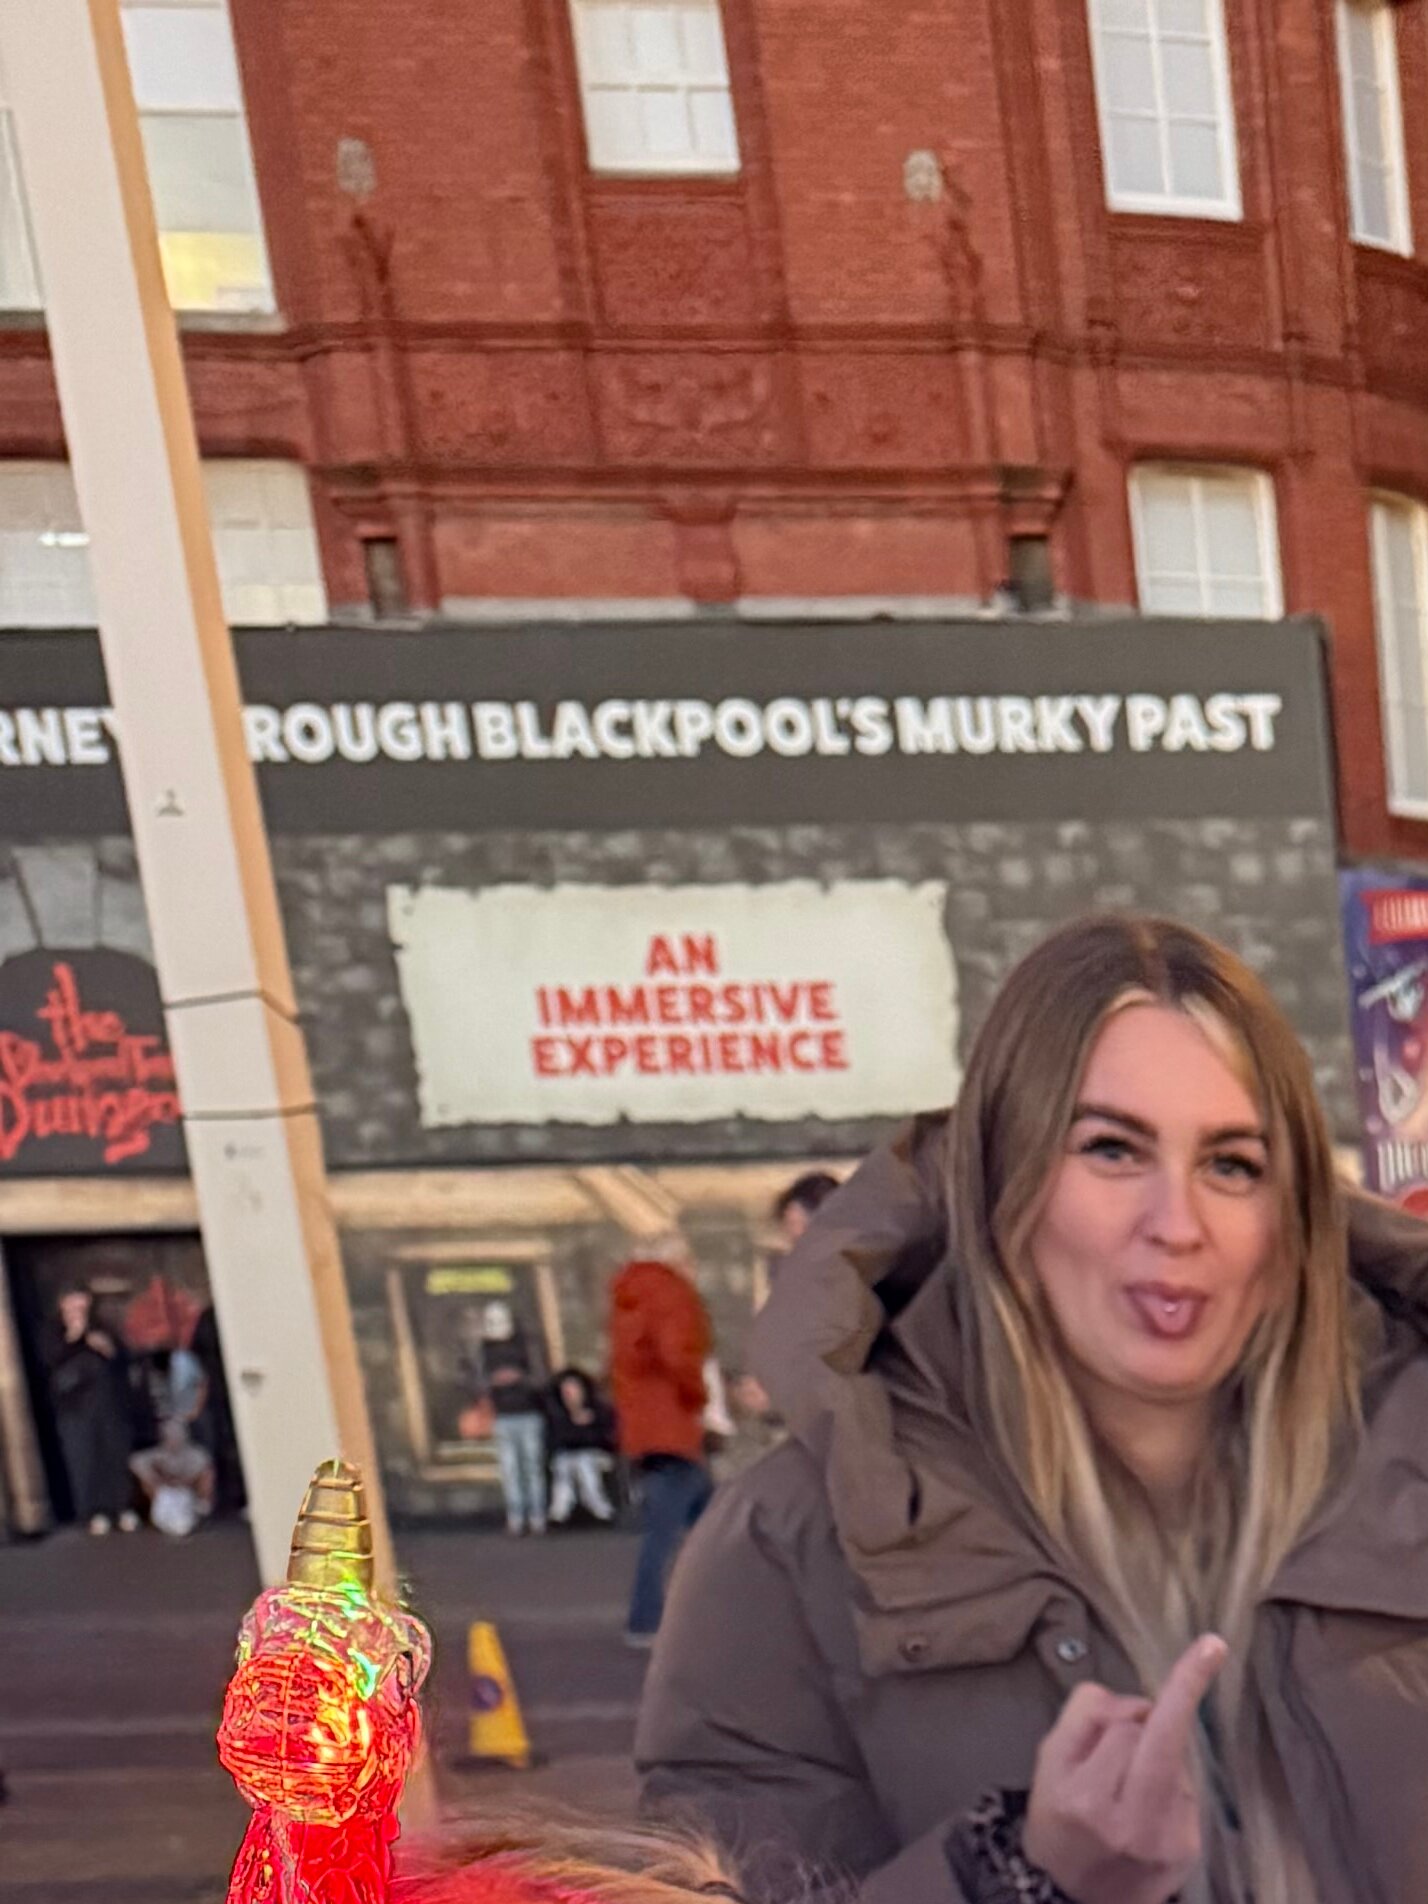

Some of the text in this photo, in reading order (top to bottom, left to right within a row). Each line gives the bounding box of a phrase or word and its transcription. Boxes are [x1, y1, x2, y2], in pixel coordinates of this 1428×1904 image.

[474, 697, 893, 763] BLACKPOOL'S
[898, 694, 1121, 755] MURKY
[1125, 693, 1283, 751] PAST
[645, 932, 721, 977] AN
[535, 981, 840, 1029] IMMERSIVE
[531, 1029, 849, 1078] EXPERIENCE
